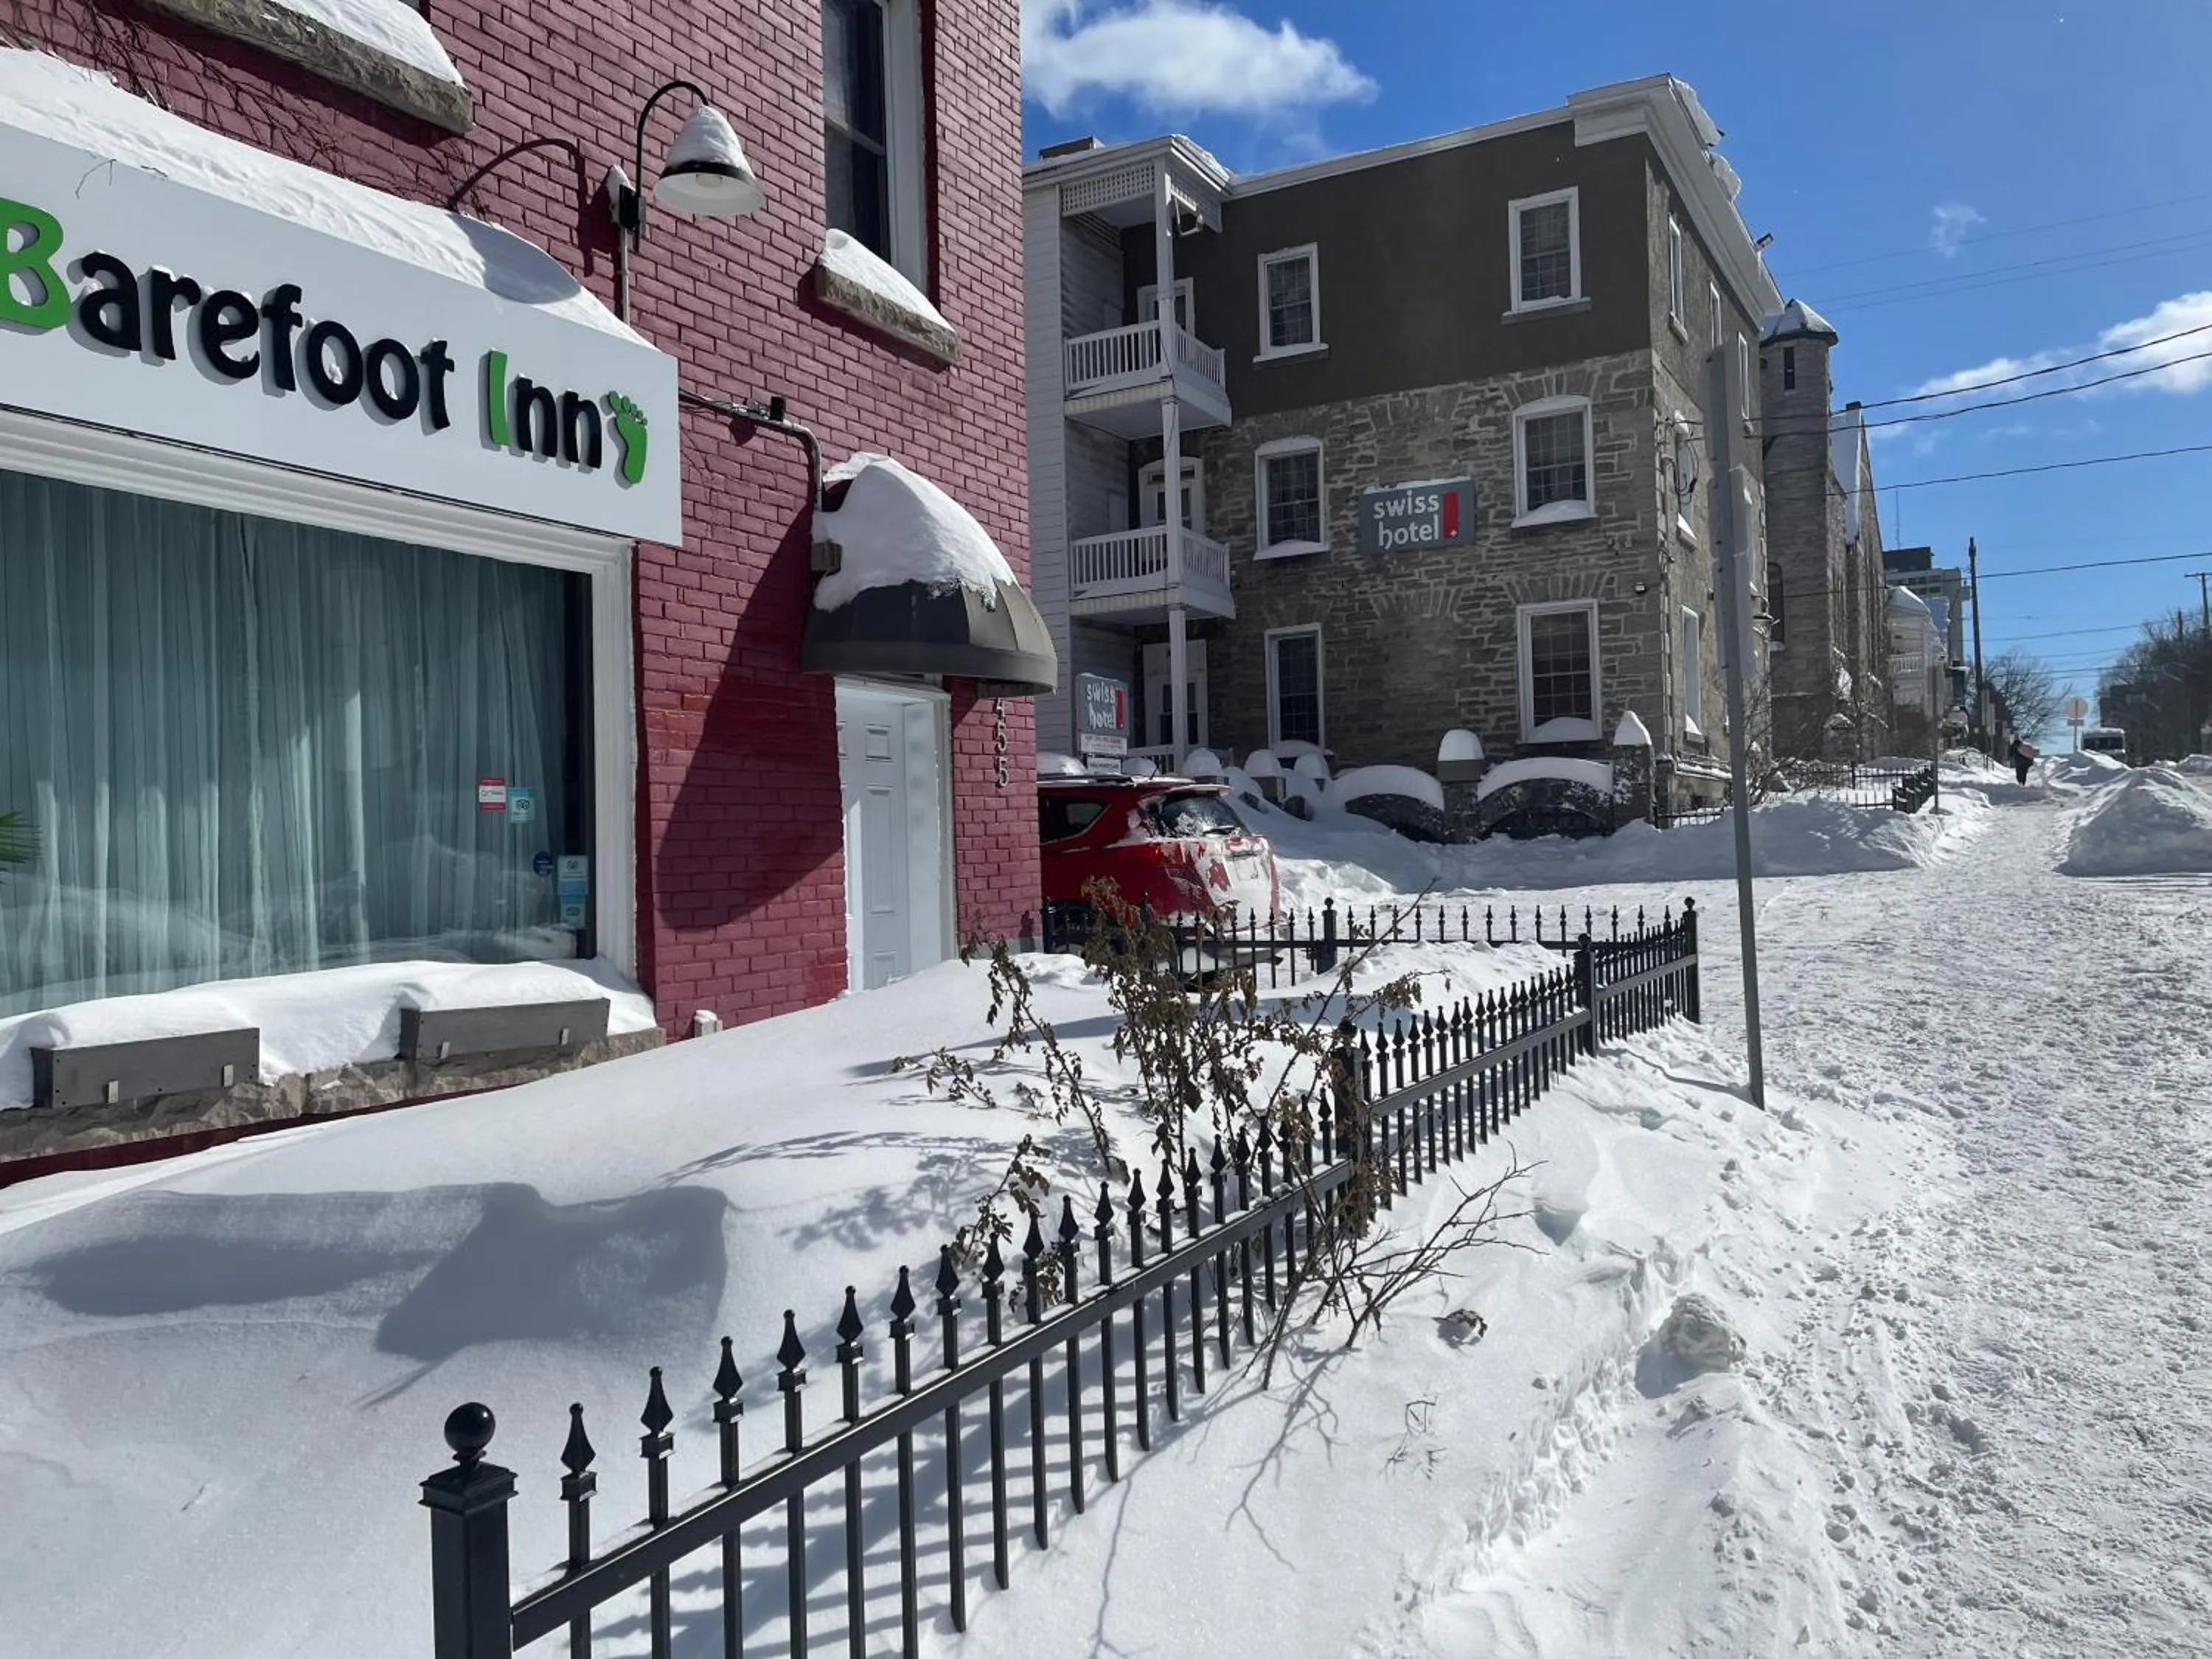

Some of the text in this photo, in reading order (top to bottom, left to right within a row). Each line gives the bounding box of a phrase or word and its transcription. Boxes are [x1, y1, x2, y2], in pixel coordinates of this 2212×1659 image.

[0, 197, 602, 469] Barefoot Inn
[1373, 489, 1440, 520] swiss
[1377, 514, 1440, 550] hotel
[1086, 681, 1116, 704] swiss
[1088, 702, 1117, 729] hotel
